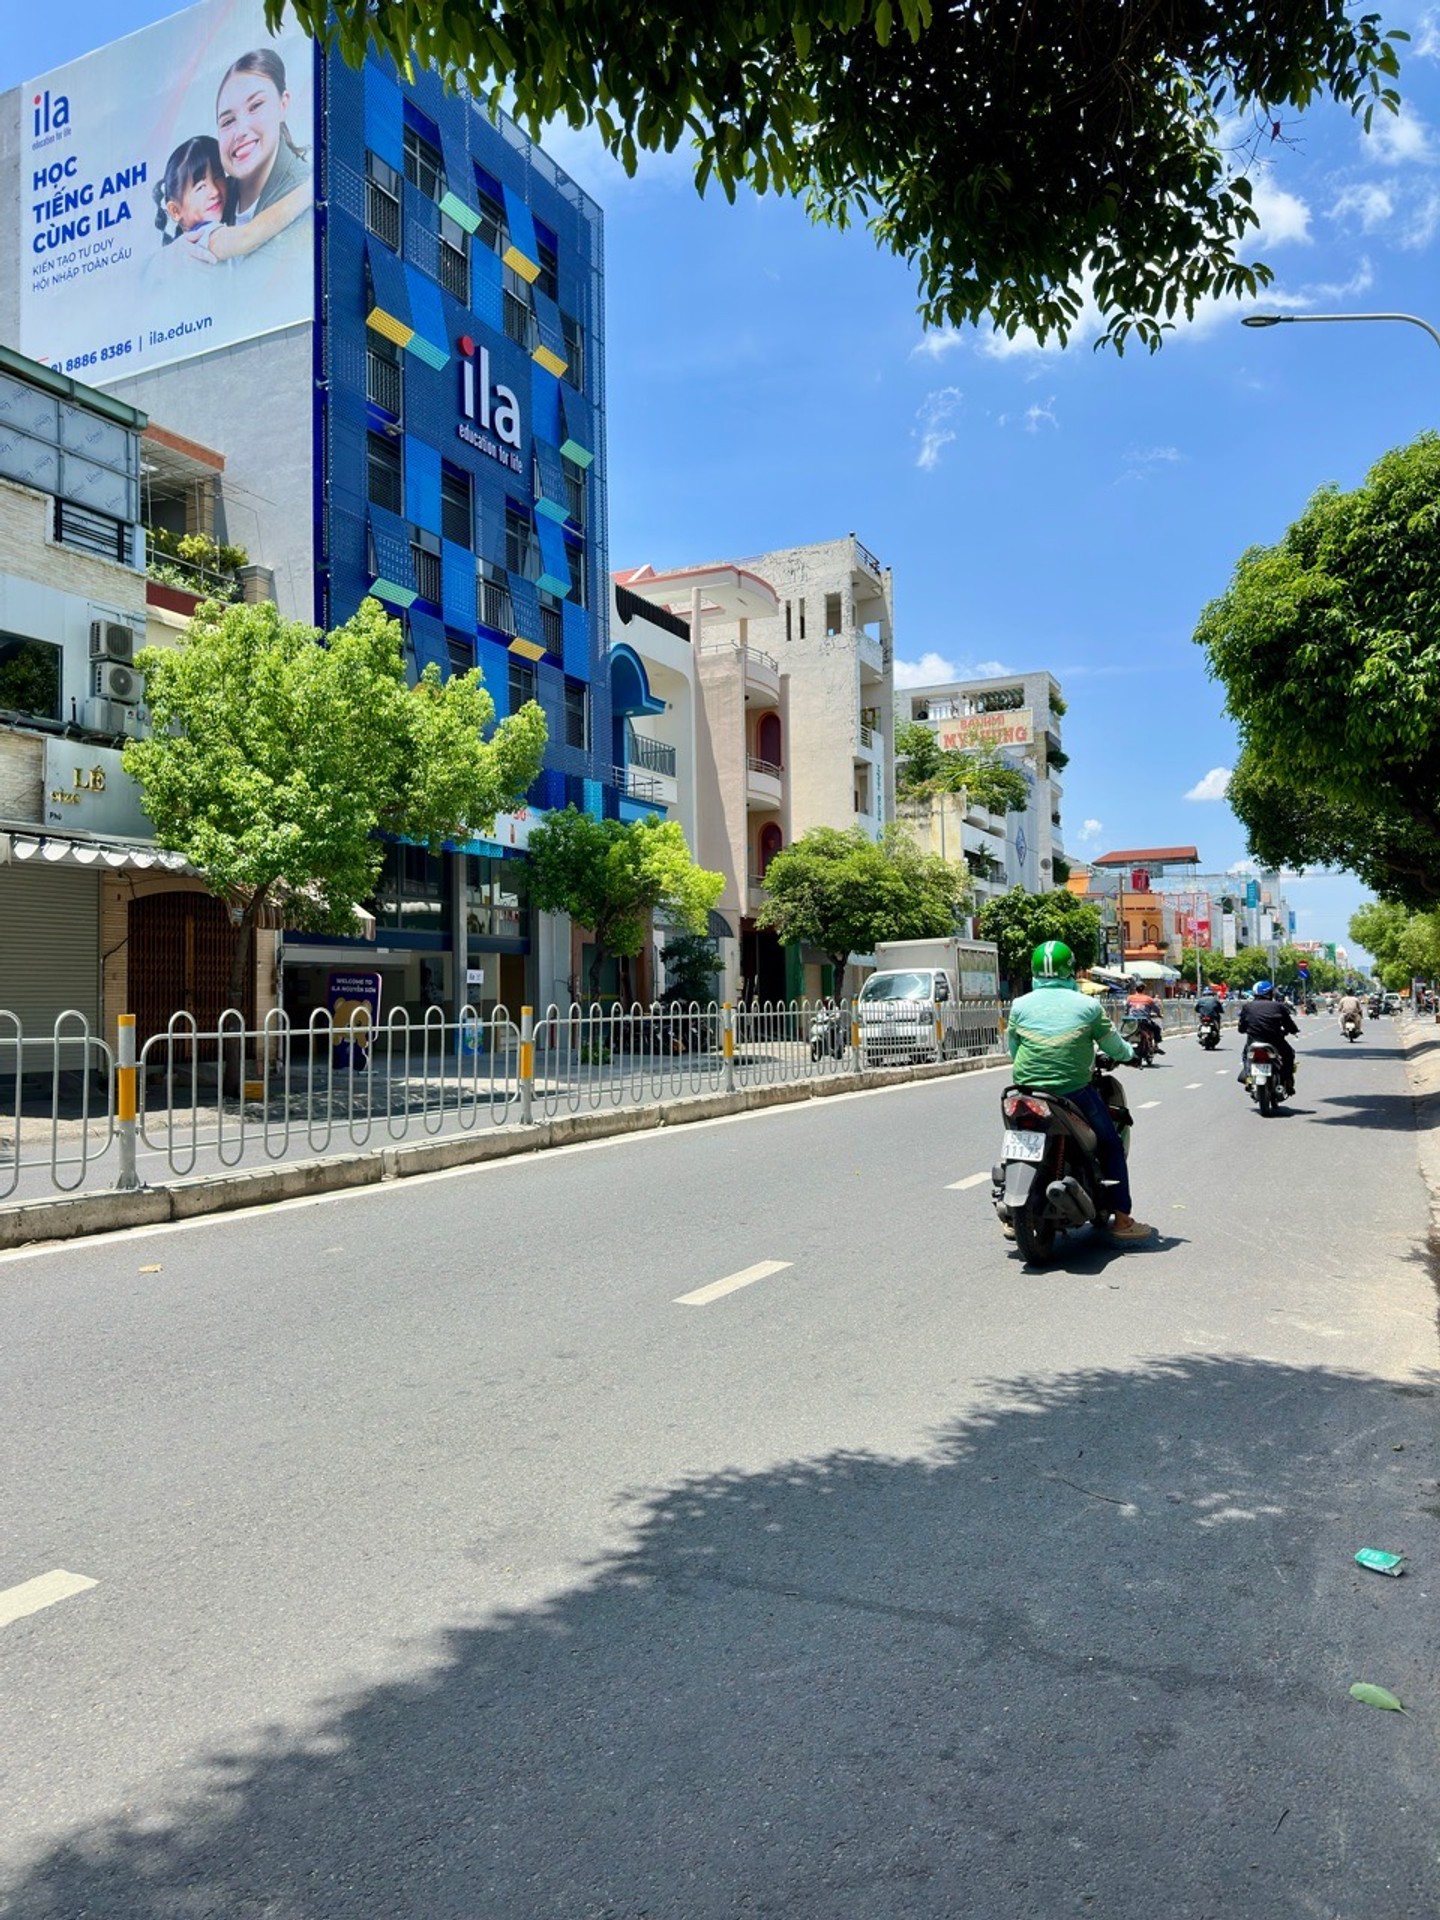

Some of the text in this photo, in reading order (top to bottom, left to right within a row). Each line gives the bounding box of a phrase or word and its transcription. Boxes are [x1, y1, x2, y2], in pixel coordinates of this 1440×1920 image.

[33, 90, 70, 138] ila
[32, 161, 147, 224] TIẾNG ANH
[33, 155, 78, 191] HỌC
[32, 200, 132, 254] CÙNG ILA
[93, 237, 115, 254] DUY
[66, 352, 98, 372] 8886
[100, 340, 132, 361] 8386
[150, 316, 213, 346] ila.edu.vn
[459, 335, 522, 450] ila
[459, 423, 523, 474] education for life
[365, 978, 373, 986] TO
